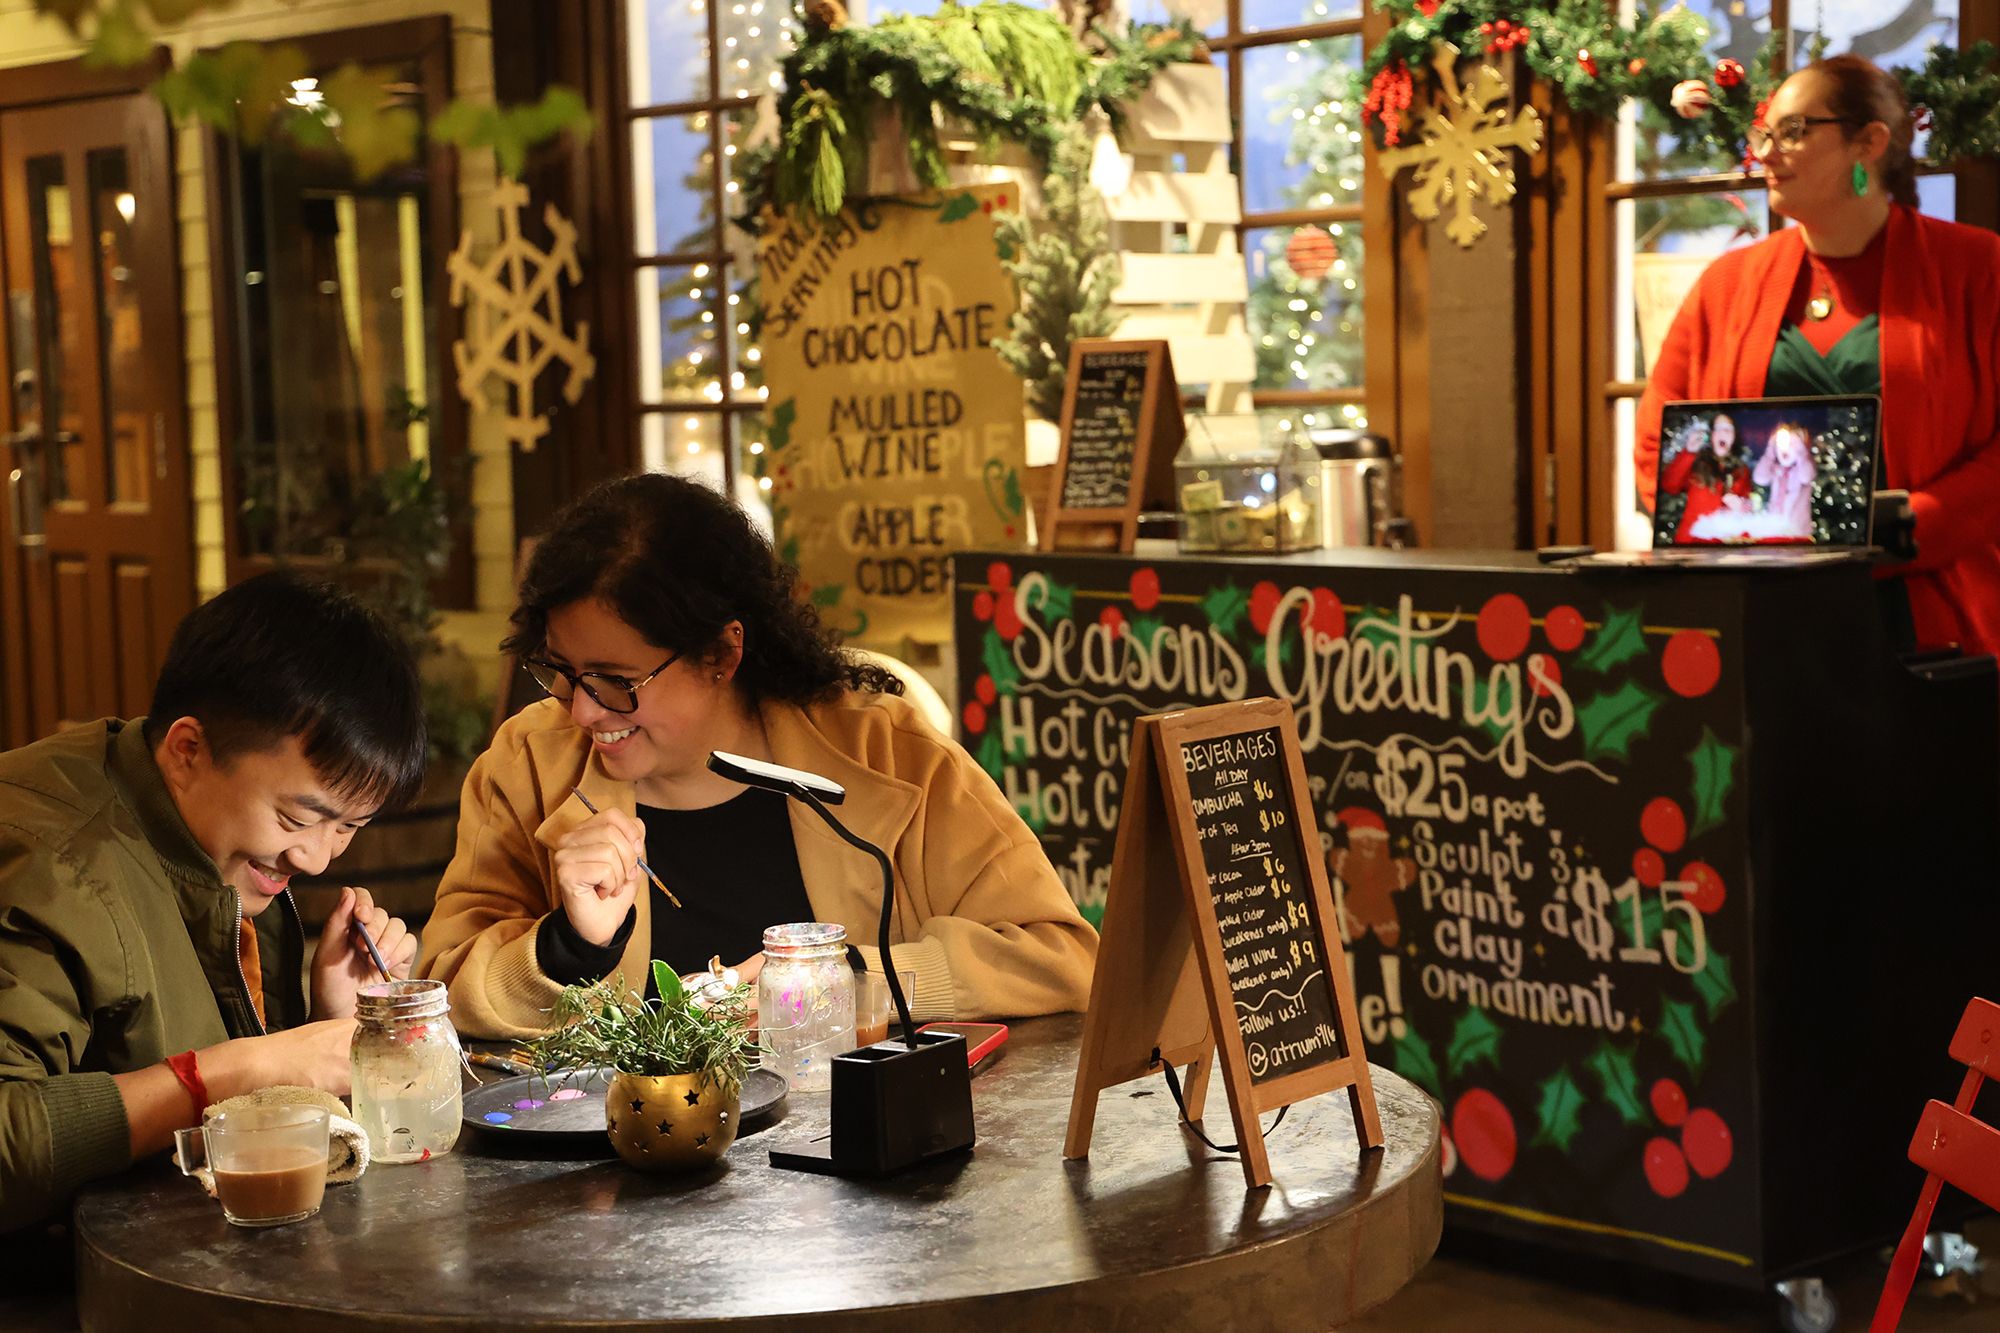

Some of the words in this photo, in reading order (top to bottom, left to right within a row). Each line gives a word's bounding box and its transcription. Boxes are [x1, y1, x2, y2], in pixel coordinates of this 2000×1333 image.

[851, 258, 922, 316] HOT
[802, 302, 995, 368] CHOCOLATE
[829, 387, 964, 433] MULLED
[833, 432, 941, 478] WINE
[851, 504, 946, 547] APPLE
[1013, 571, 1248, 700] Seasons
[1265, 585, 1575, 779] Greetings
[1001, 694, 1089, 760] Hot
[1180, 731, 1277, 773] BEVERAGES
[1003, 765, 1091, 828] Hot
[1229, 768, 1249, 783] DAY
[1253, 778, 1274, 802] $6
[1372, 734, 1470, 823] $25
[1470, 794, 1489, 818] a
[1493, 791, 1547, 837] pot
[1221, 821, 1239, 836] Tea
[1259, 809, 1285, 833] $10
[1263, 855, 1285, 877] $6
[1411, 819, 1534, 888] Sculpt
[1270, 876, 1291, 900] $6
[1286, 899, 1310, 930] $9
[1418, 868, 1526, 929] Paint
[1571, 865, 1708, 975] $15
[1289, 940, 1316, 969] $9
[1237, 1011, 1275, 1036] Follow
